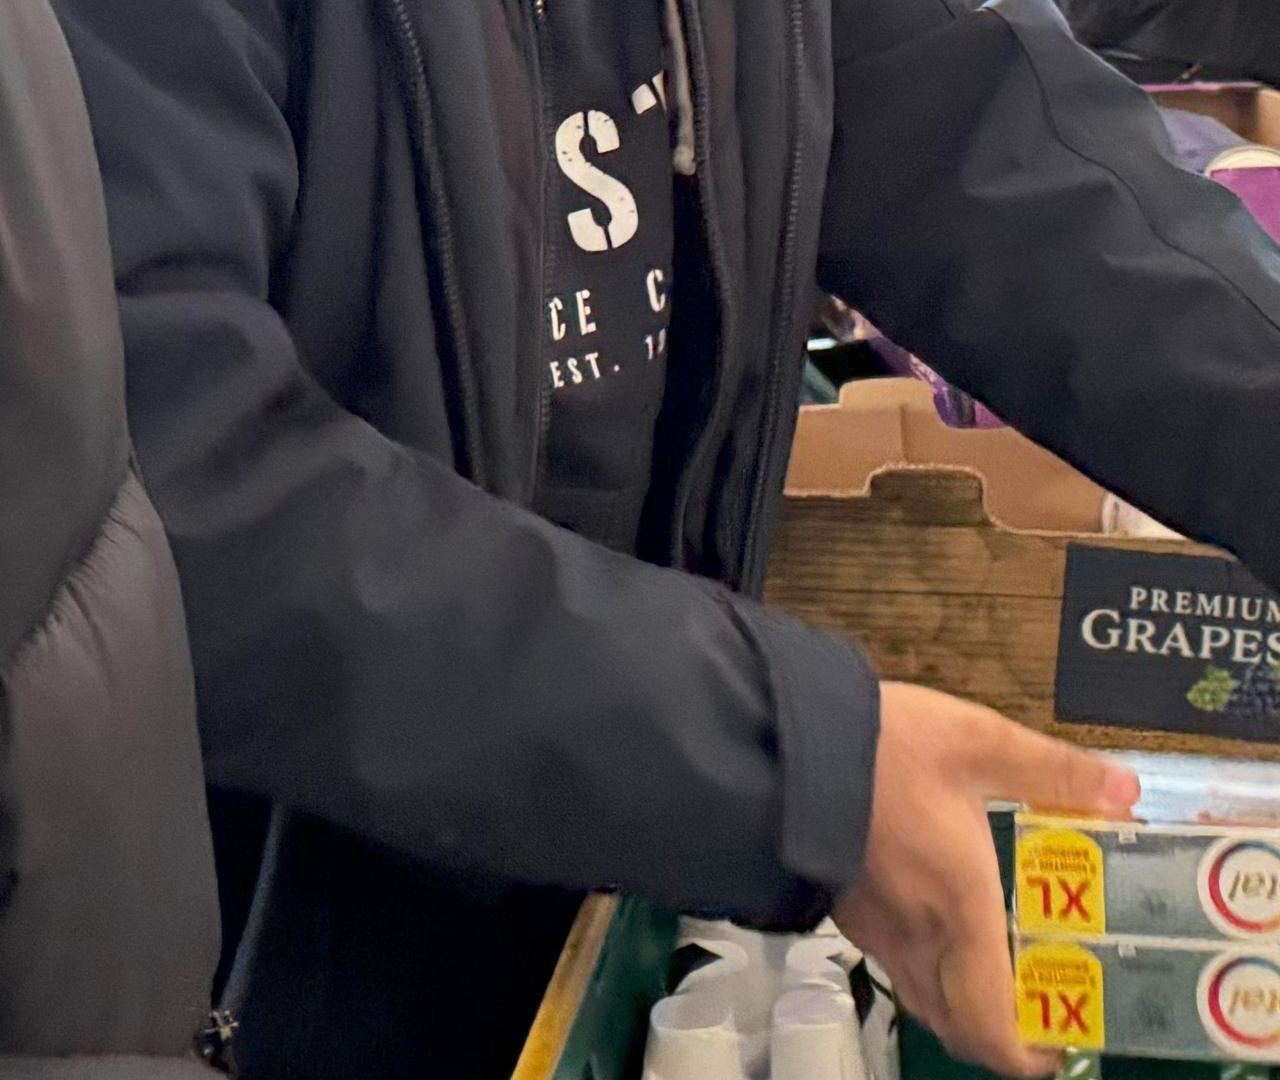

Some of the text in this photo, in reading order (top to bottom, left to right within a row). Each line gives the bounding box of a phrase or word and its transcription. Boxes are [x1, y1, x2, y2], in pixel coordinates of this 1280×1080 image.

[549, 352, 620, 388] EST.
[1026, 875, 1092, 923] XL
[1025, 991, 1092, 1036] XL
